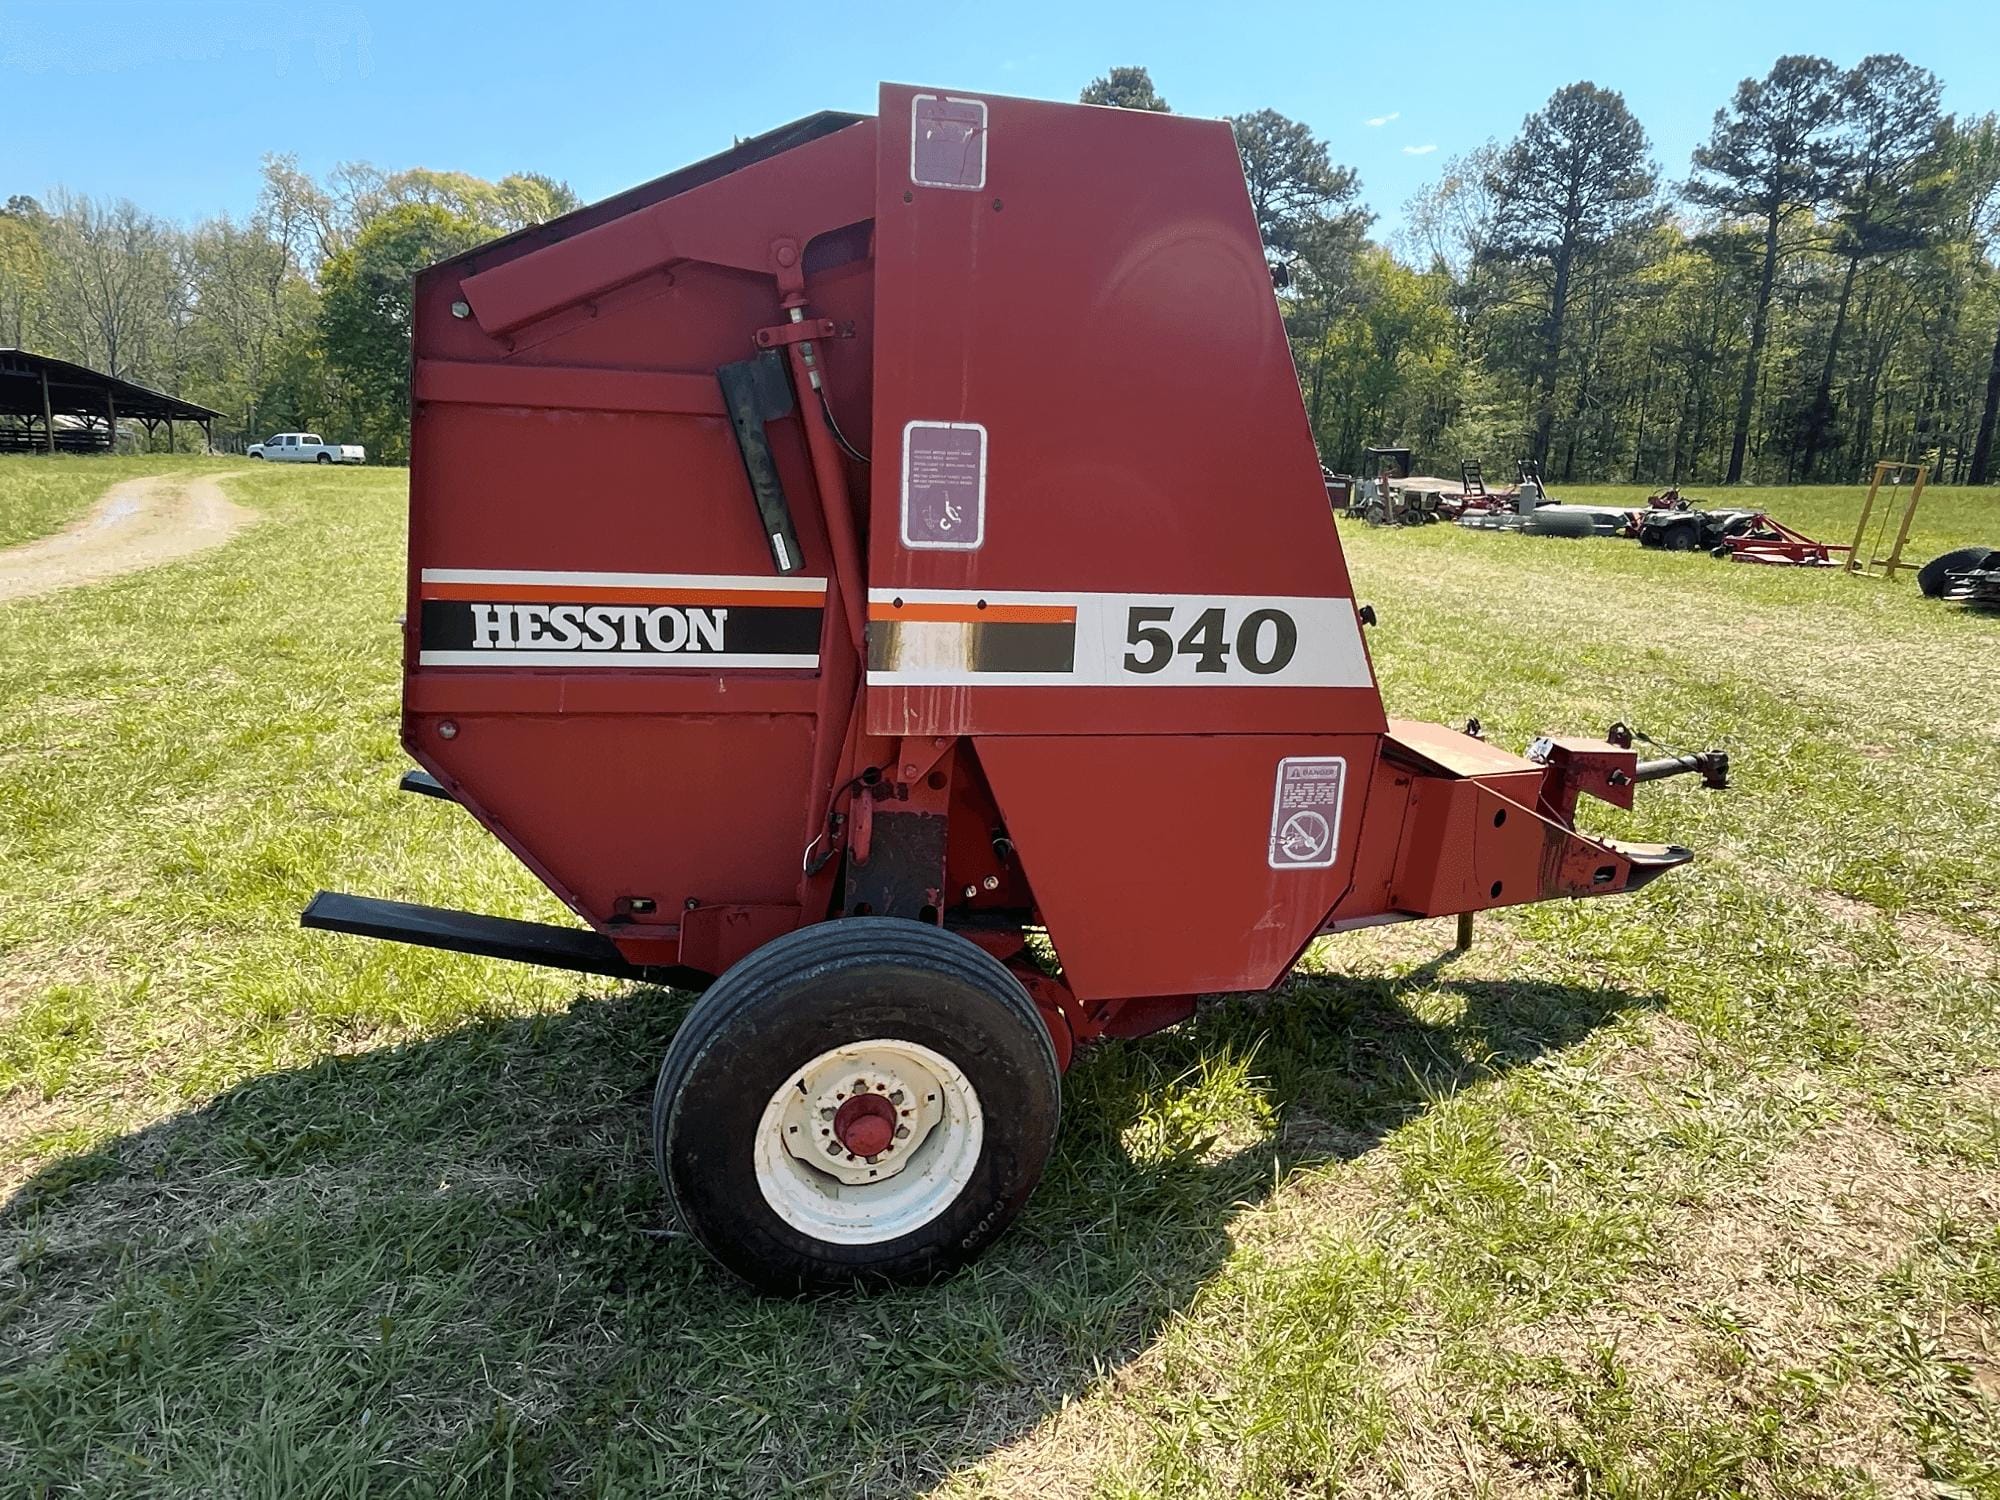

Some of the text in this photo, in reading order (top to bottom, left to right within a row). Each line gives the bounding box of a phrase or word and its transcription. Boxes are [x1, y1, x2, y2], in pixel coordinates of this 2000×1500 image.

[470, 604, 728, 652] HESSTON
[1123, 606, 1298, 675] 540
[1302, 768, 1335, 776] DANGER
